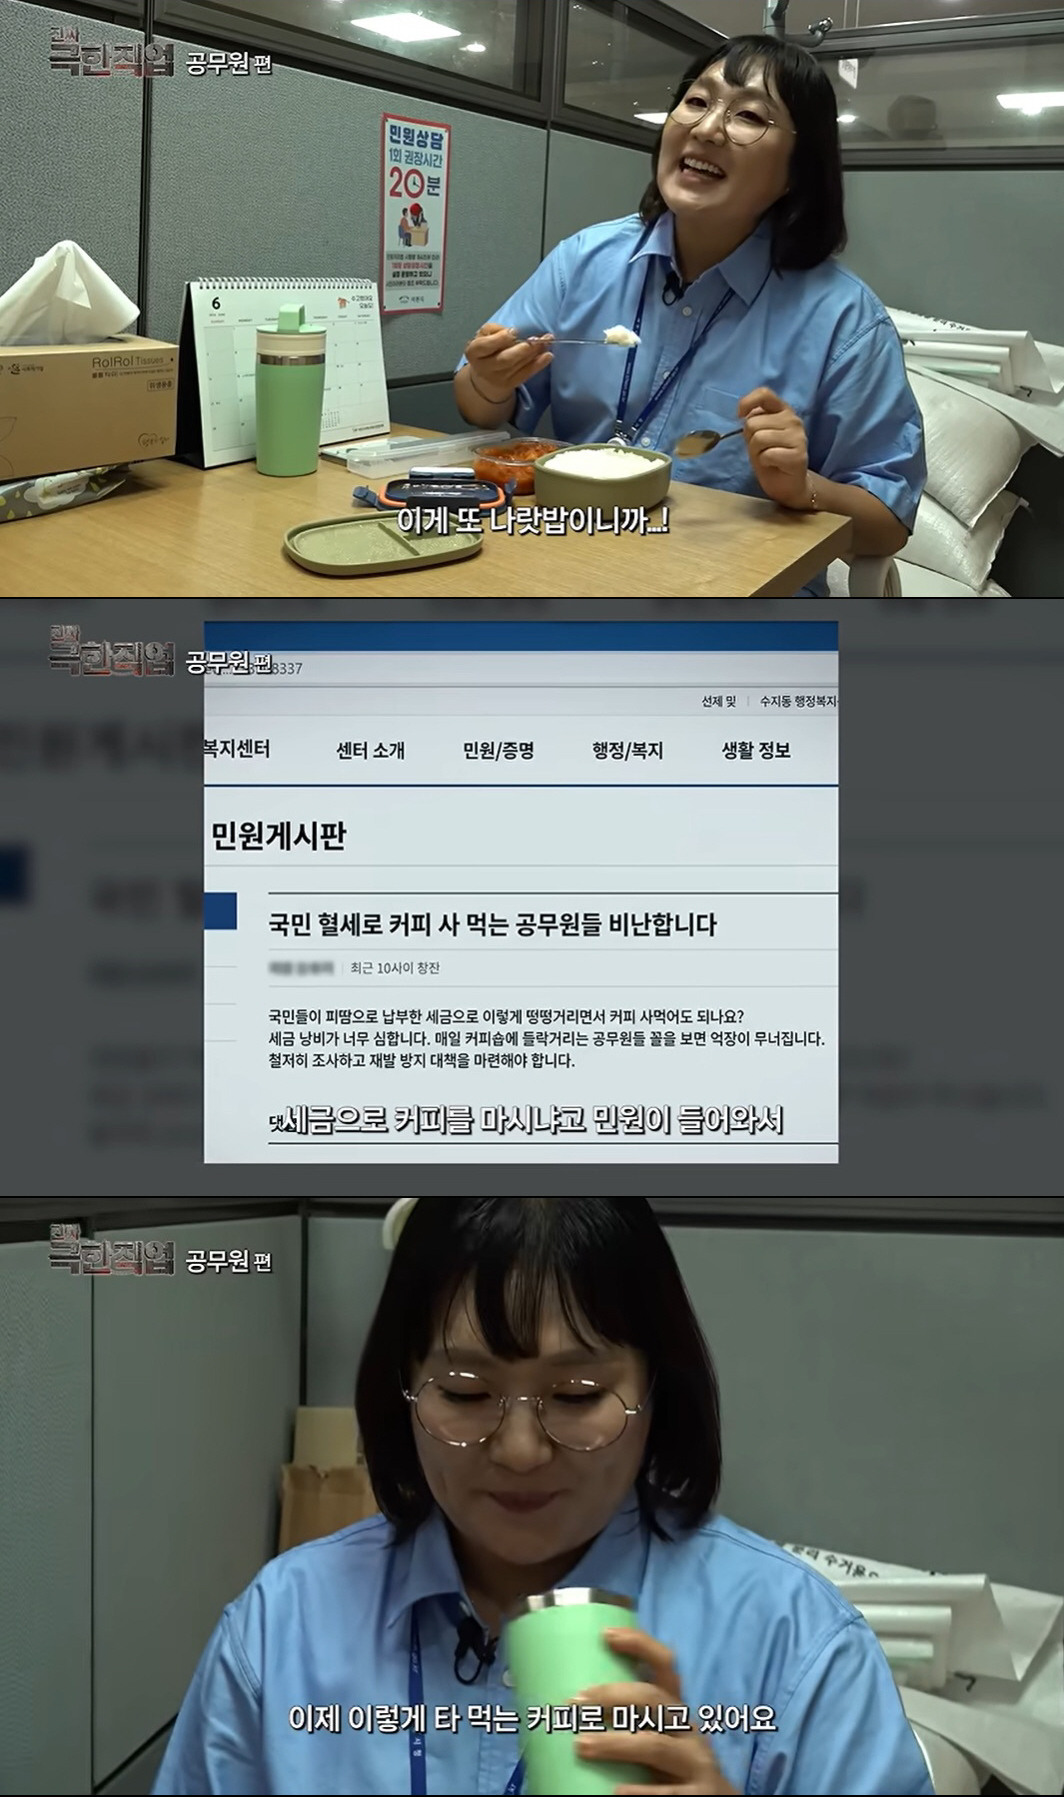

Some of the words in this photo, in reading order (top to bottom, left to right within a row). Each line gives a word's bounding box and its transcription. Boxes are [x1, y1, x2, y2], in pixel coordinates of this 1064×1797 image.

[389, 124, 444, 151] 민원상담
[389, 147, 402, 163] 1회
[404, 150, 443, 168] 권장시간
[212, 296, 221, 310] 6
[135, 356, 164, 366] Tissues
[760, 695, 791, 708] 수지동
[794, 695, 839, 708] 행정복지
[203, 739, 270, 759] 복지센터
[336, 741, 368, 760] 센터
[373, 741, 405, 760] 소개
[463, 741, 534, 761] 민원/증명
[592, 741, 664, 761] 행정/복지
[721, 741, 755, 760] 생활
[758, 741, 791, 760] 정보
[212, 821, 347, 851] 민원게시판
[268, 912, 311, 937] 국민
[318, 912, 383, 937] 혈세로
[388, 912, 431, 937] 커피
[438, 912, 460, 937] 사
[466, 912, 509, 937] 먹는
[515, 912, 602, 937] 공무원들
[608, 912, 718, 937] 비난합니다
[350, 961, 374, 975] 최근
[376, 961, 414, 975] 10사이
[416, 961, 440, 975] 창잔
[268, 1009, 321, 1025] 국민들이
[325, 1009, 378, 1025] 피땀으로
[382, 1009, 422, 1025] 납부한
[425, 1009, 479, 1025] 세금으로
[482, 1009, 522, 1025] 이렇게
[526, 1009, 606, 1025] 떵떵거리면서
[609, 1009, 636, 1025] 커피
[640, 1009, 693, 1025] 사먹어도
[697, 1009, 745, 1025] 되나요?
[268, 1031, 296, 1047] 세금
[299, 1031, 340, 1047] 낭비가
[343, 1031, 370, 1047] 너무
[373, 1031, 430, 1047] 심합니다.
[435, 1031, 461, 1047] 매일
[465, 1031, 519, 1047] 커피숍에
[522, 1031, 589, 1047] 들락거리는
[592, 1031, 646, 1047] 공무원들
[650, 1031, 676, 1047] 꼴을
[680, 1031, 706, 1047] 보면
[710, 1031, 750, 1047] 억장이
[754, 1031, 825, 1047] 무너집니다.
[268, 1052, 308, 1069] 철저히
[312, 1052, 366, 1069] 조사하고
[369, 1052, 396, 1069] 재발
[400, 1052, 426, 1069] 방지
[430, 1052, 470, 1069] 대책을
[474, 1052, 527, 1069] 마련해야
[531, 1052, 575, 1069] 합니다.
